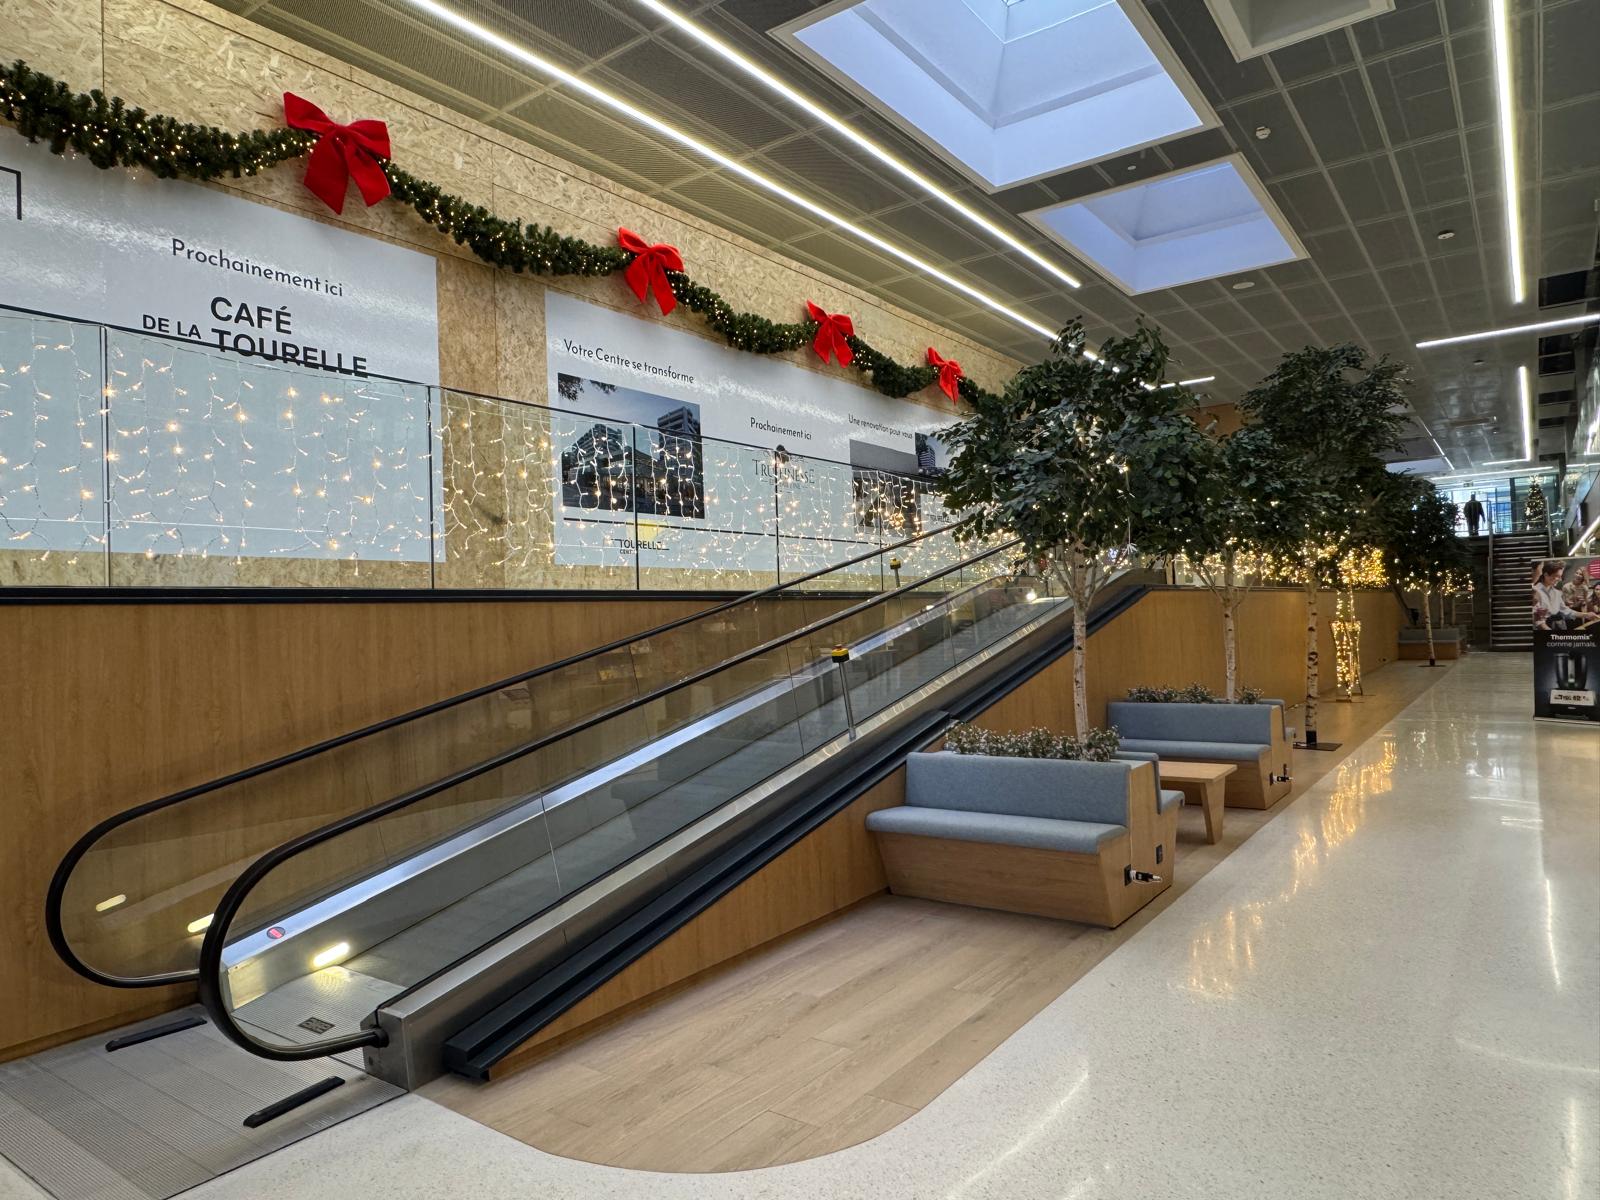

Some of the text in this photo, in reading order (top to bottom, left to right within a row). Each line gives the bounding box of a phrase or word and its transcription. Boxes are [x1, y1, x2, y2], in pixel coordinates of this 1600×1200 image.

[172, 238, 343, 297] Prochainement ici
[210, 296, 292, 335] CAFÉ
[142, 314, 368, 379] DE LA TOURELLE
[563, 338, 695, 384] Votre Centre se transforme
[750, 416, 812, 441] Prochainement ici
